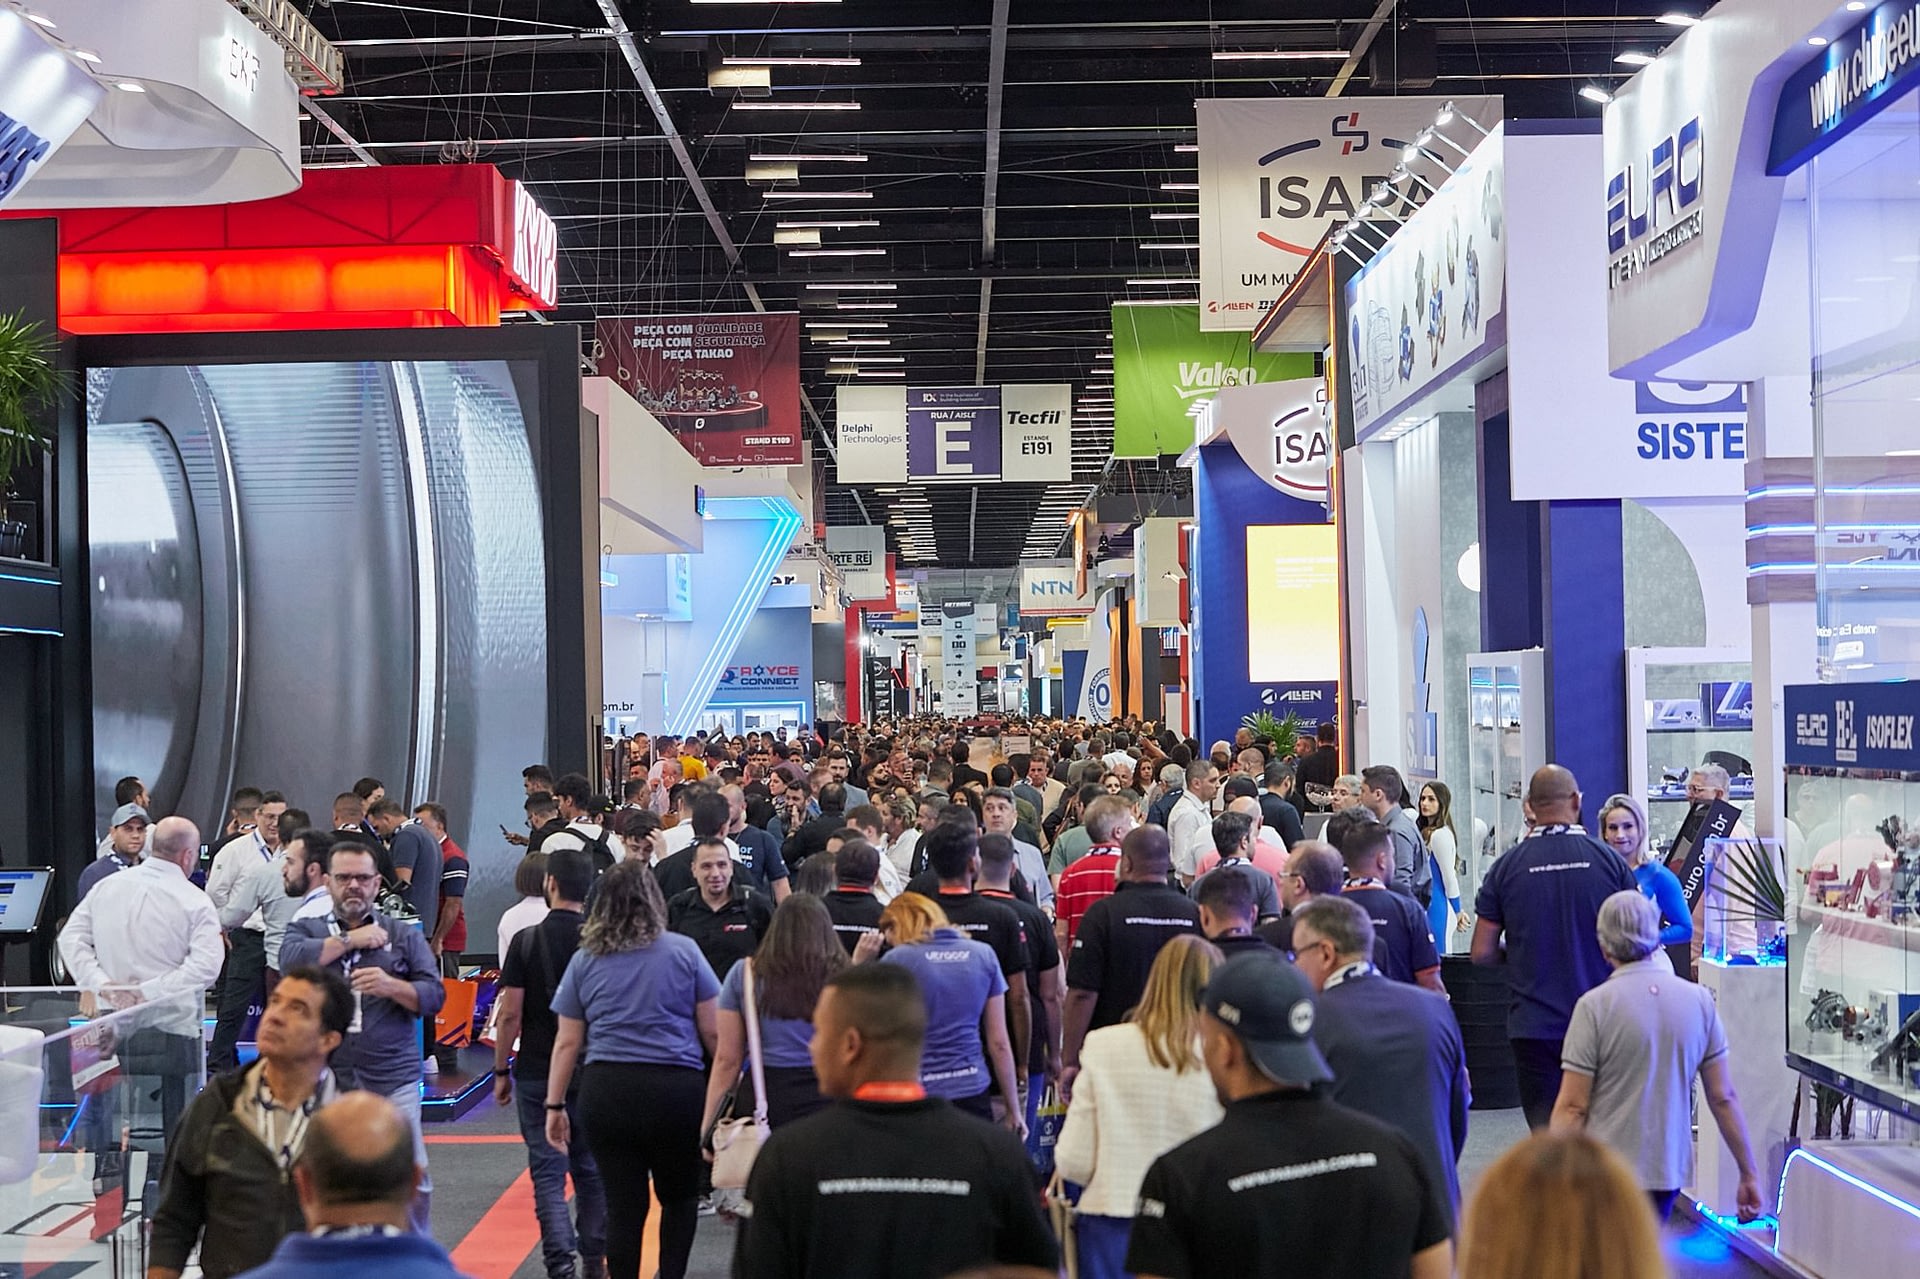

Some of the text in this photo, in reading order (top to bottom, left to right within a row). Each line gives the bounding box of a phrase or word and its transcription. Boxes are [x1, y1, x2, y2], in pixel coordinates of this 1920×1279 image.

[1607, 115, 1704, 255] EURO
[1241, 273, 1267, 287] UM
[634, 322, 763, 337] PEÇA COM QUALIDADE
[633, 335, 766, 350] PEÇA COM SEGURANÇA
[662, 348, 734, 362] PEÇA TAKAO
[1178, 361, 1257, 387] Valeo
[954, 411, 977, 419] AISLE
[1007, 410, 1061, 425] Tecfil
[842, 424, 873, 433] Delphi
[745, 437, 771, 445] STAND
[842, 434, 902, 445] Technologies
[1637, 421, 1747, 460] SISTE
[936, 421, 973, 474] E
[1022, 442, 1052, 455] E191
[1031, 580, 1073, 596] NTN
[1796, 713, 1828, 737] EURO
[1865, 715, 1914, 750] ISOFLEX
